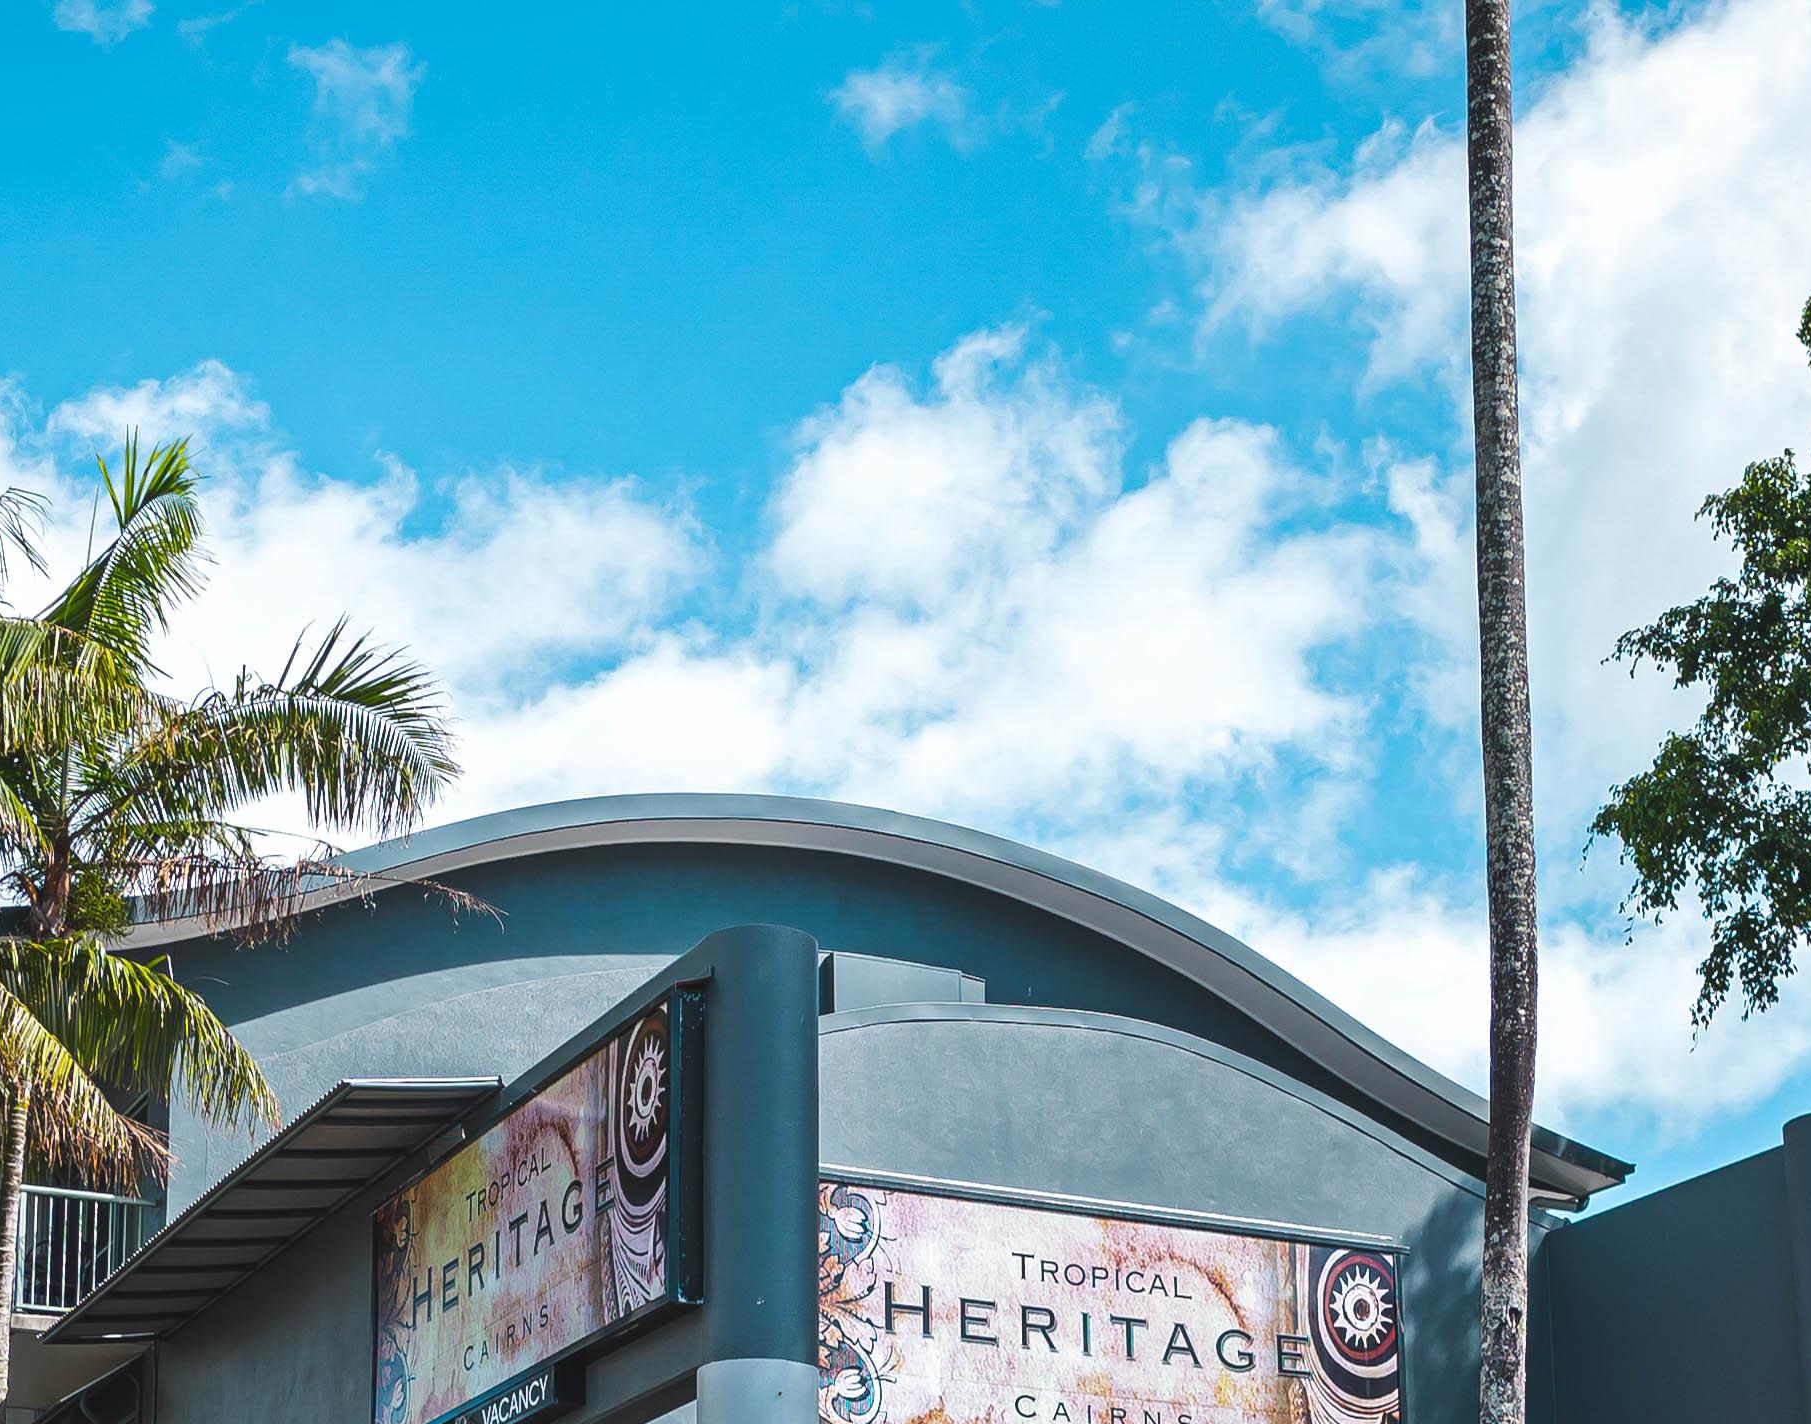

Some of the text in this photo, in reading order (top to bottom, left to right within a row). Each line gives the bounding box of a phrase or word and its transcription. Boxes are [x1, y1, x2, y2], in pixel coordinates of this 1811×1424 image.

[465, 1147, 552, 1223] TROPICAL
[410, 1156, 615, 1331] HERITAGE
[1011, 1252, 1193, 1300] TROPICAL
[463, 1303, 550, 1372] CAIRNS
[883, 1281, 1314, 1378] HERITAGE
